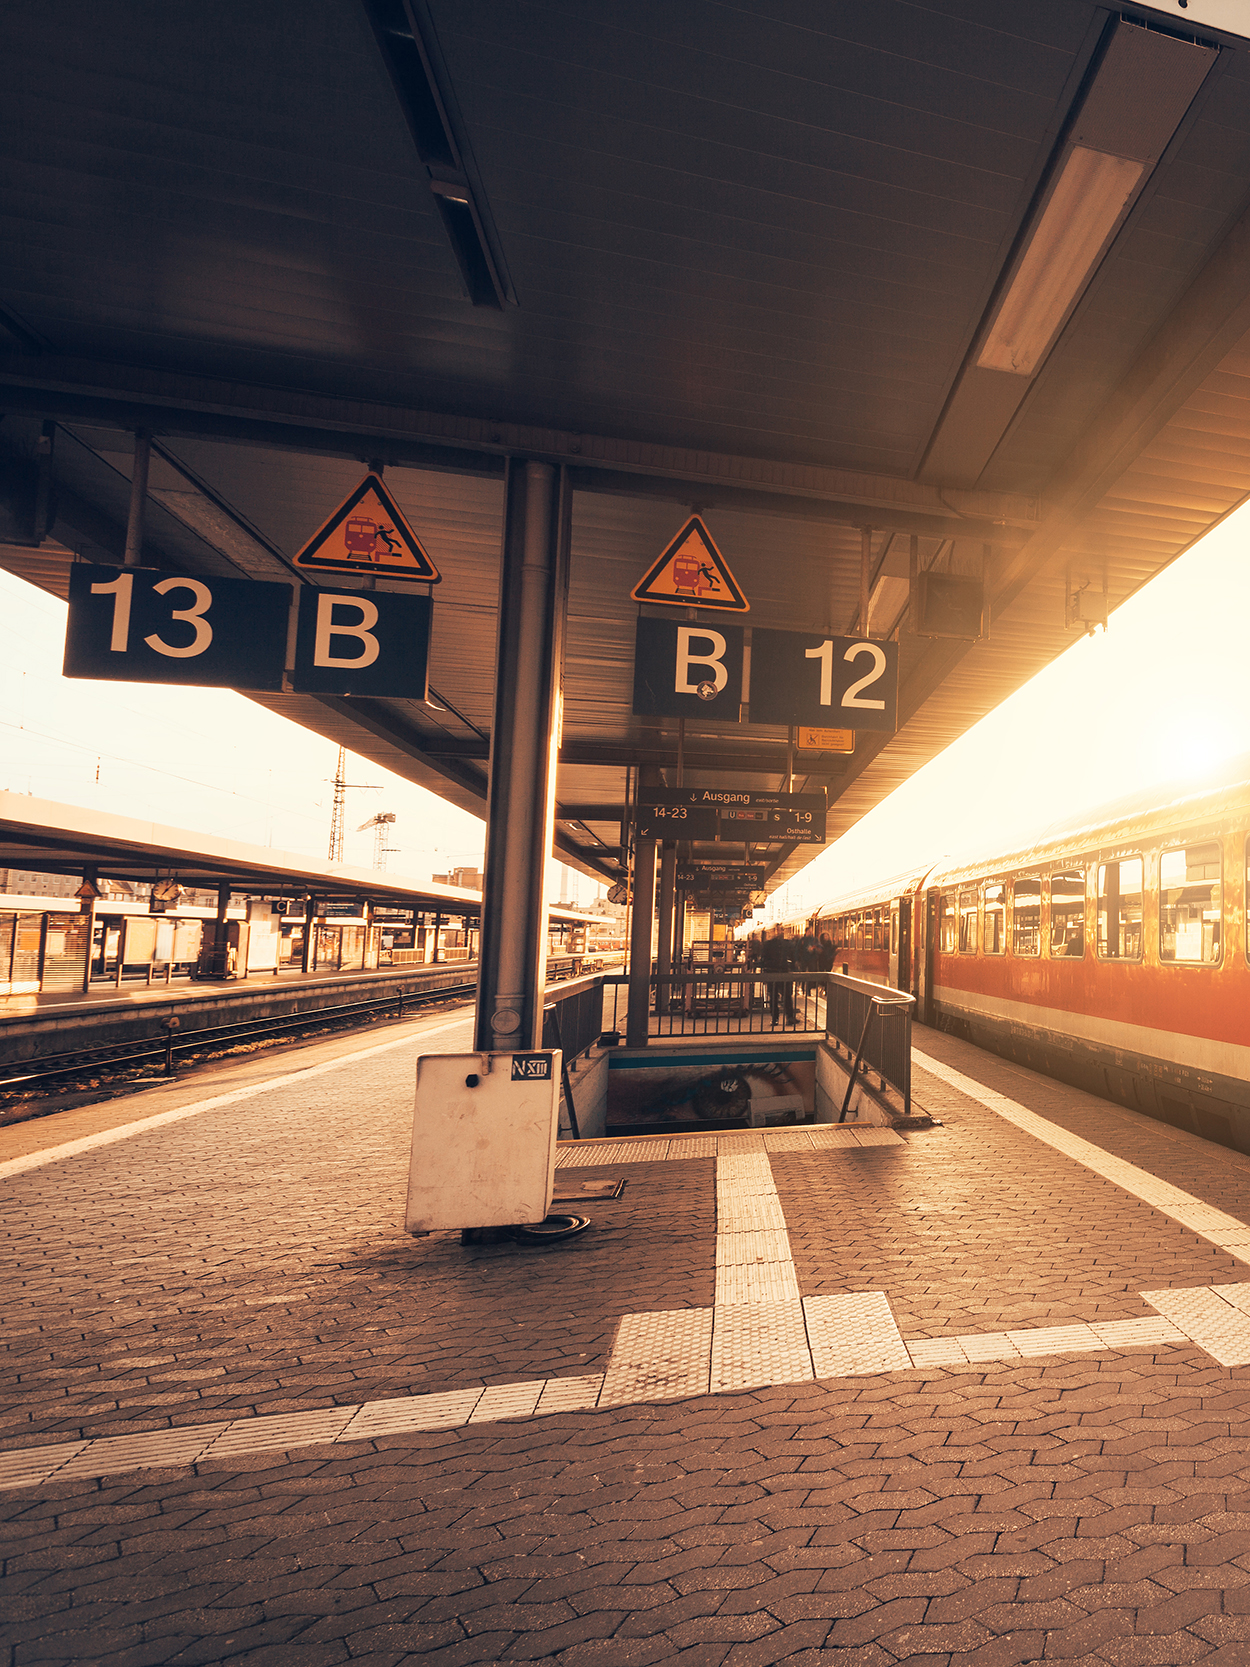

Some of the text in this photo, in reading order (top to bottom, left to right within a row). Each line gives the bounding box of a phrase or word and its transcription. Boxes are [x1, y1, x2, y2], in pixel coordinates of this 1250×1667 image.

[91, 573, 213, 658] 13
[313, 593, 380, 669] B
[675, 626, 728, 694] B
[805, 640, 887, 710] 12
[653, 807, 687, 819] 14-23
[702, 790, 750, 805] Ausgang
[794, 812, 812, 823] 1-9
[701, 865, 726, 873] Ausgang
